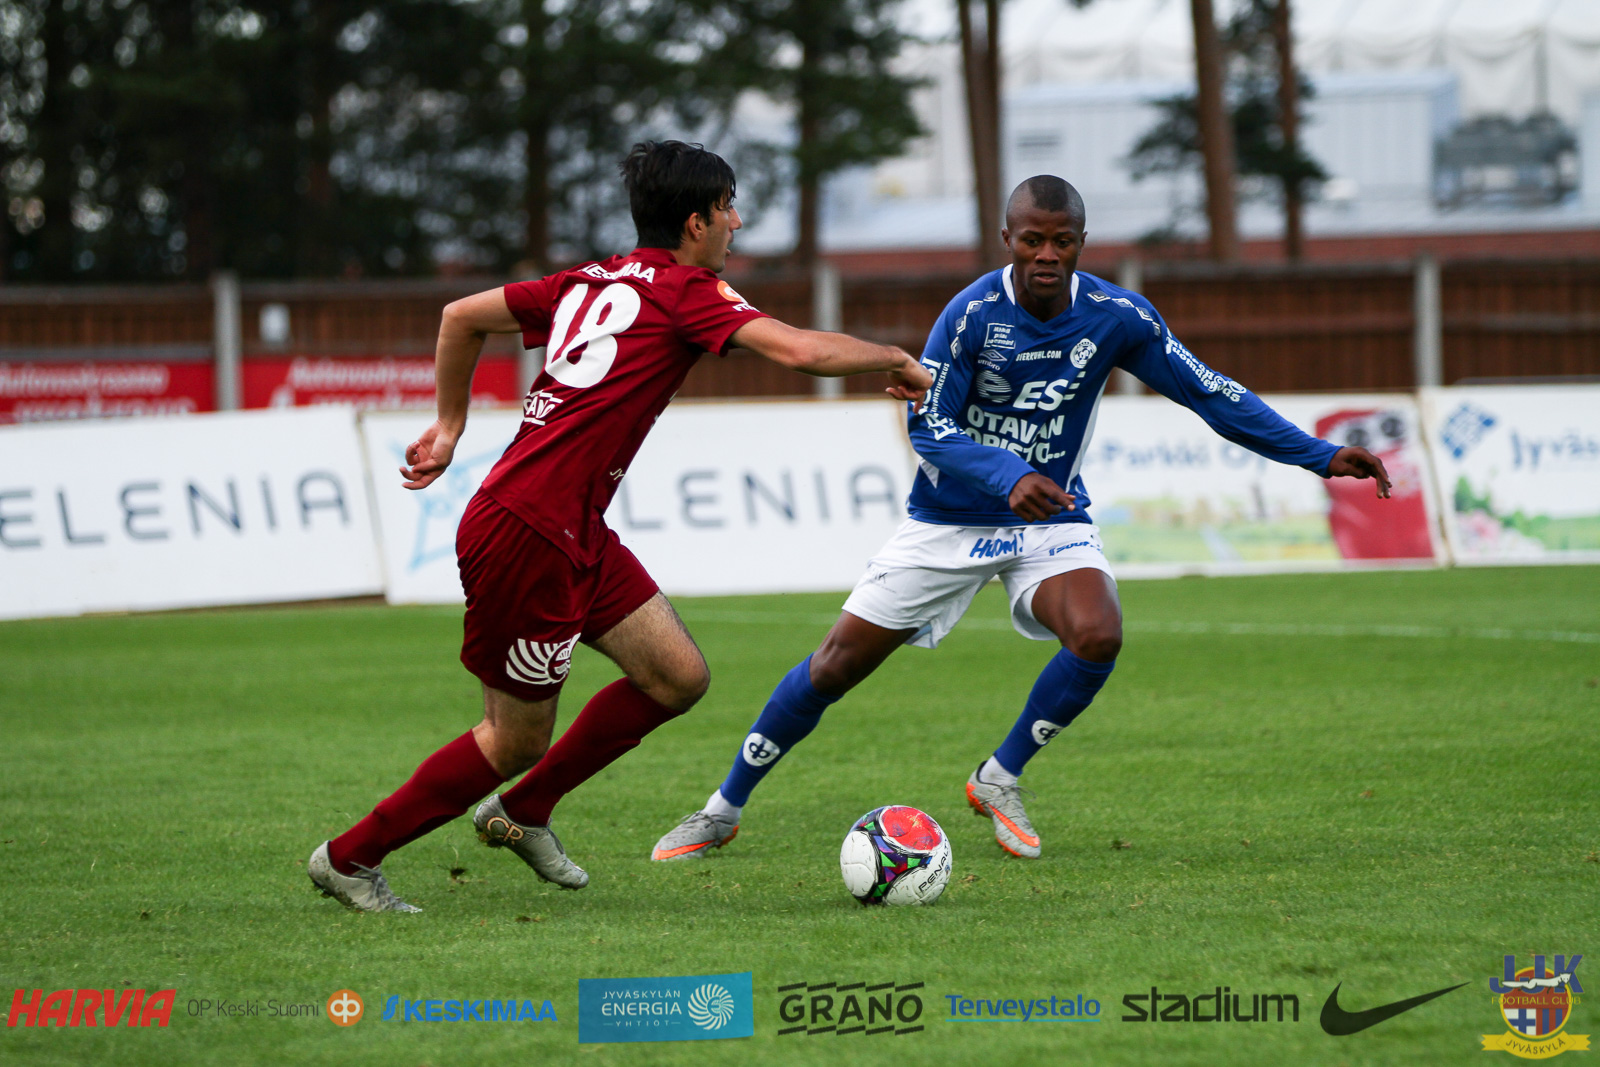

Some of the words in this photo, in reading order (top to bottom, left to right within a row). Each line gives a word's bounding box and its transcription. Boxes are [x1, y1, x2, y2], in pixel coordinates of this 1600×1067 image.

[545, 283, 641, 389] 18
[966, 404, 1065, 445] OTAVAN
[0, 470, 353, 549] ELENIA
[618, 463, 901, 531] LENIA
